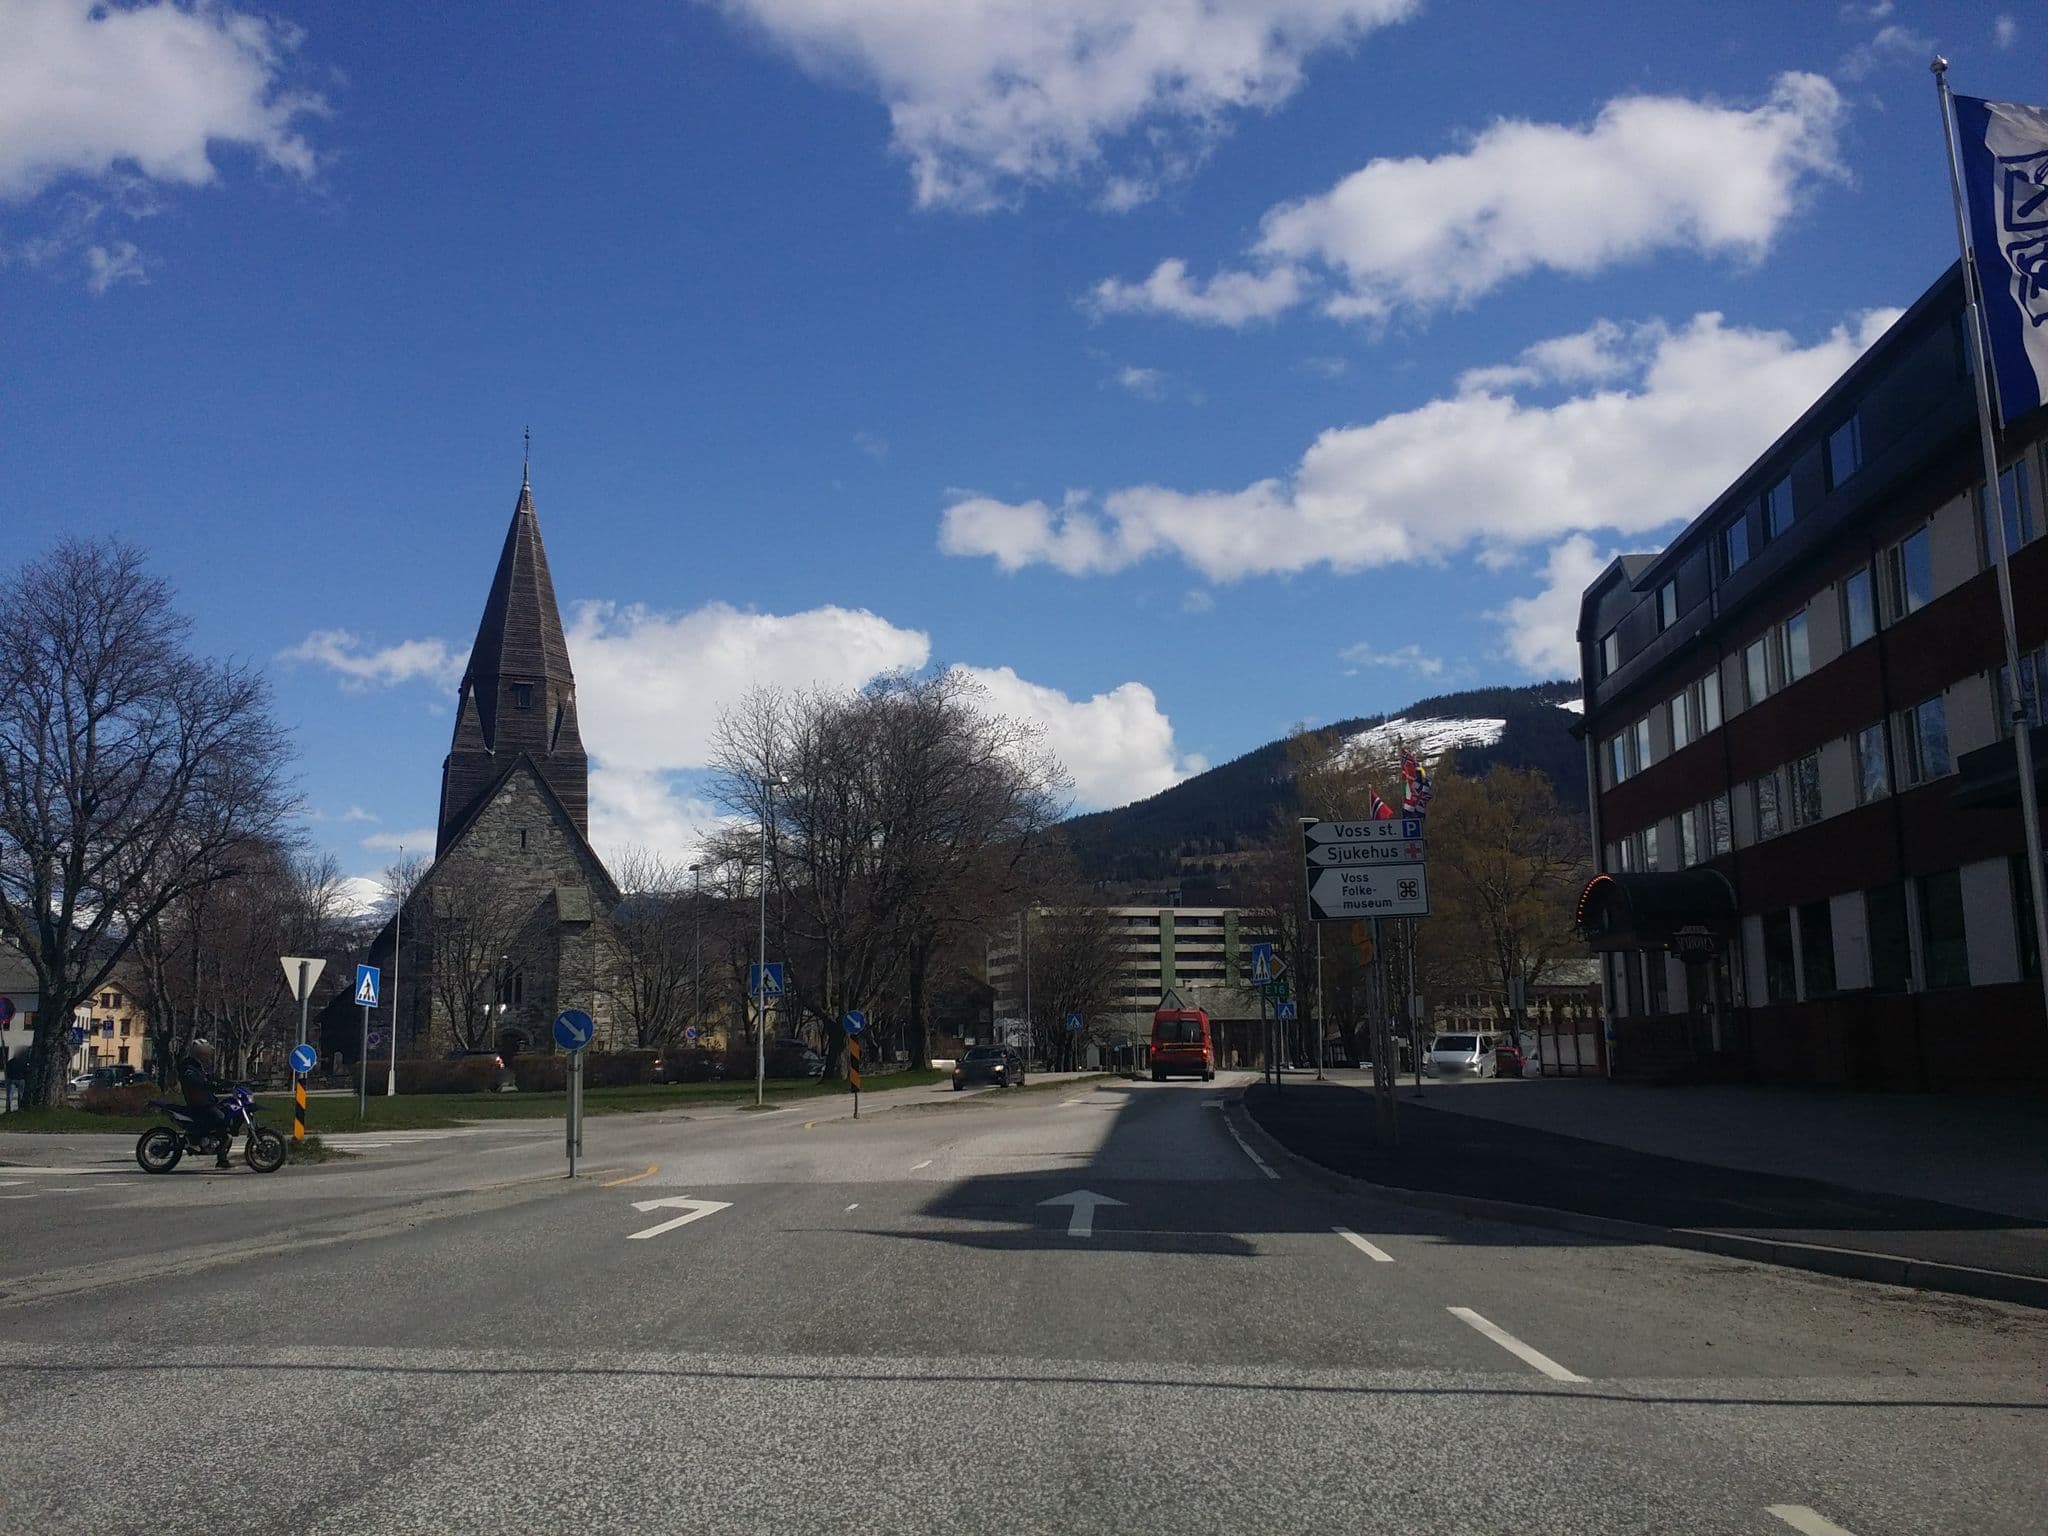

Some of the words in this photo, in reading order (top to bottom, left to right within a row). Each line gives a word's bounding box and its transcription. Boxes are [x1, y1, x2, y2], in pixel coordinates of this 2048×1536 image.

[1334, 824, 1371, 838] Voss
[1378, 823, 1397, 836] st.
[1406, 821, 1416, 836] P
[1327, 846, 1399, 863] Sjukehus
[1341, 873, 1369, 883] Voss
[1342, 886, 1377, 896] Folke-
[1343, 899, 1393, 909] museum
